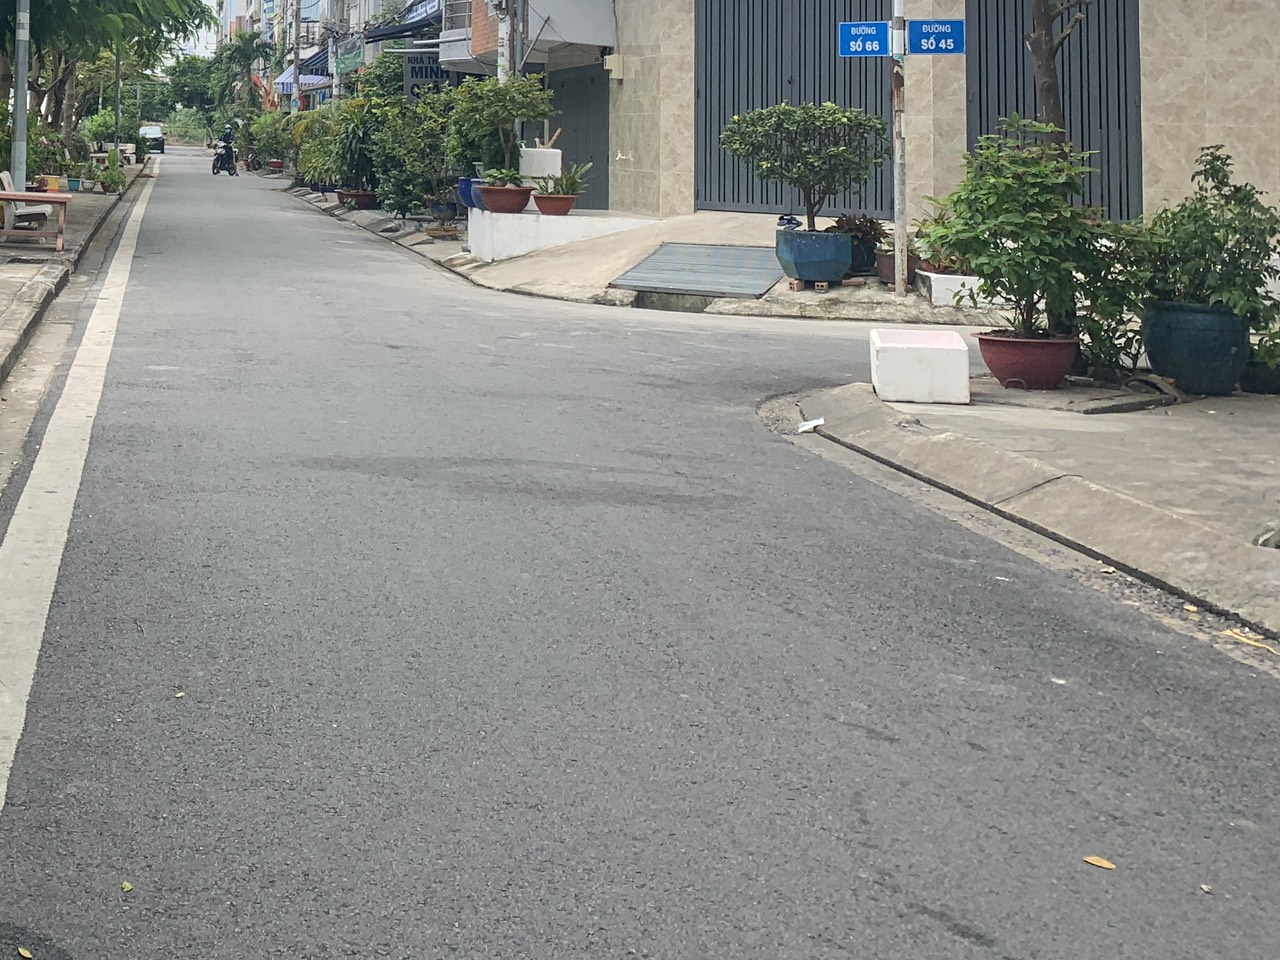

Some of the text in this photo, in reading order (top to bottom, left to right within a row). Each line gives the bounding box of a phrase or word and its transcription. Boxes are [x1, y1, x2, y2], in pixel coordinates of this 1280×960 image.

[851, 25, 876, 35] ĐƯỜNG
[922, 24, 951, 33] ĐƯỜNG
[850, 37, 879, 51] SỐ 66
[921, 35, 954, 50] SỐ 45
[408, 54, 424, 64] NHÀ
[411, 66, 449, 79] MINH
